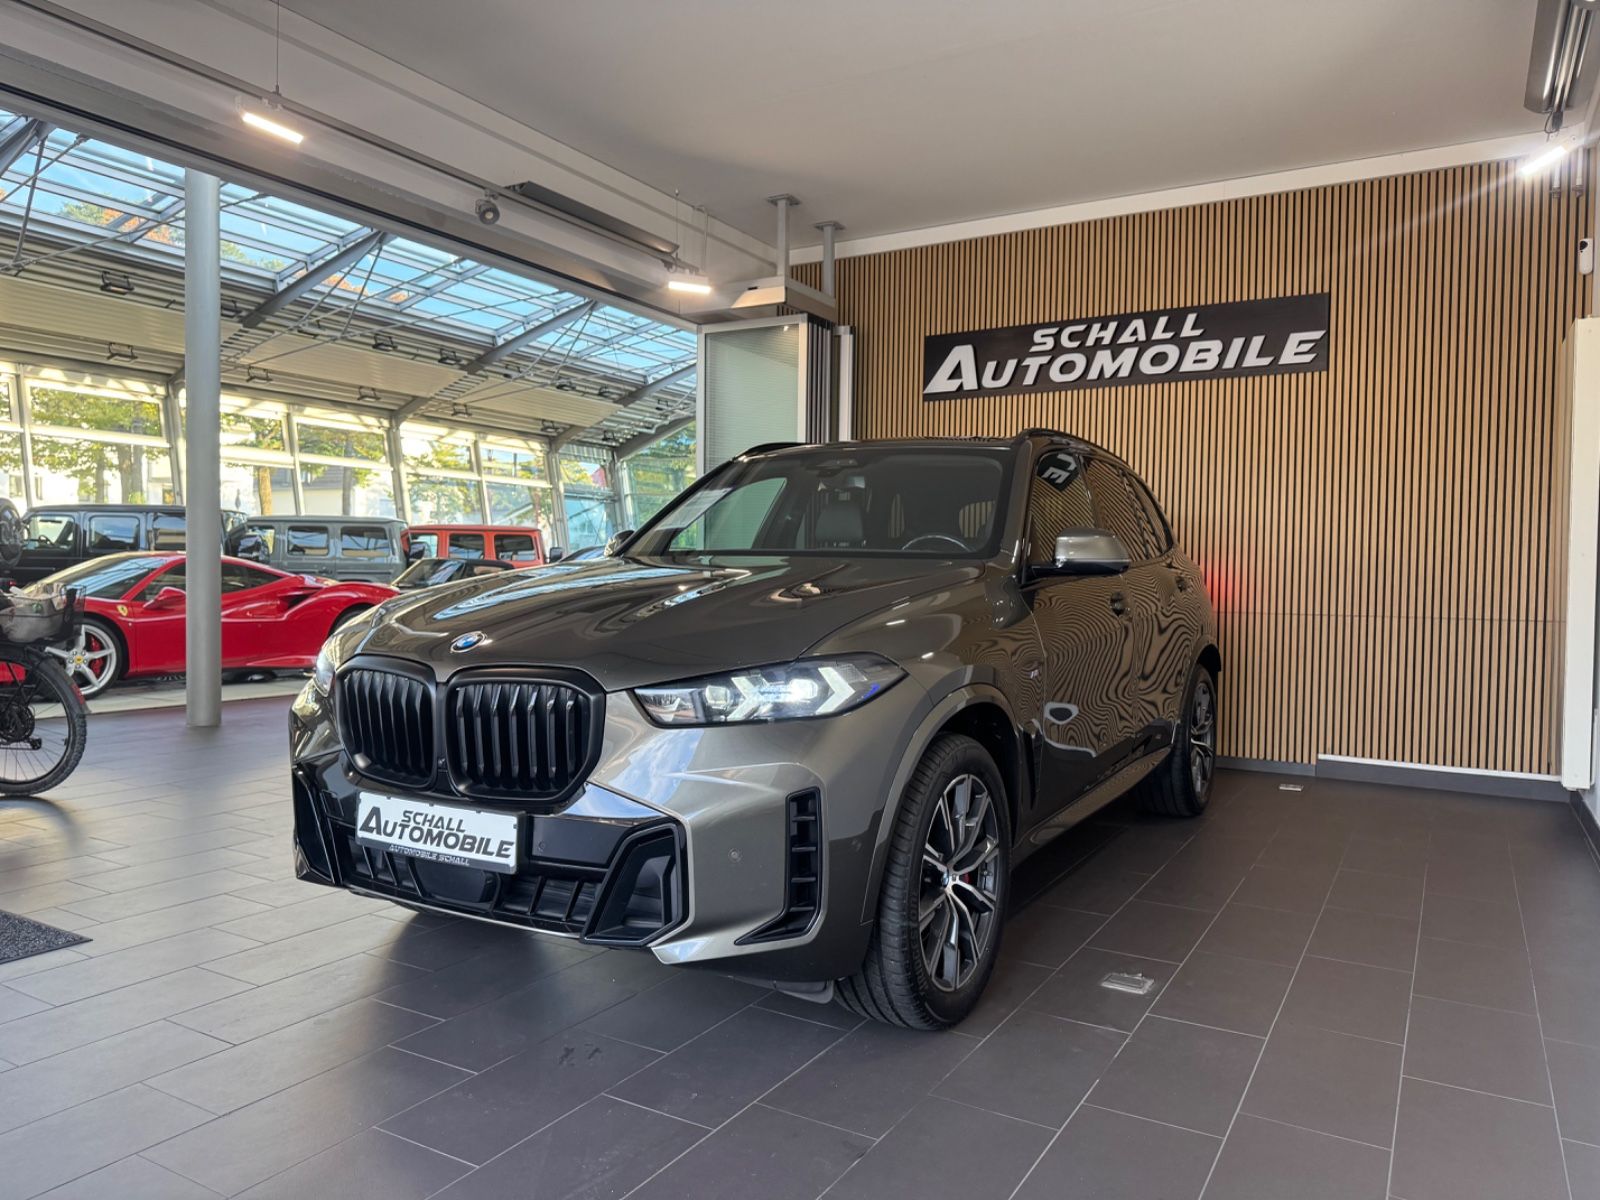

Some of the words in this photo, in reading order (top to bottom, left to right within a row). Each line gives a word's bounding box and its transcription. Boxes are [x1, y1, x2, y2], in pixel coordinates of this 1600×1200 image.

[1029, 312, 1205, 353] SCHALL
[923, 329, 1327, 395] AUTOMOBILE
[359, 806, 515, 859] AUTOMOBILE
[400, 810, 466, 833] SCHALL
[390, 844, 438, 859] AUTOMOBILE
[439, 855, 470, 866] SCHALL
